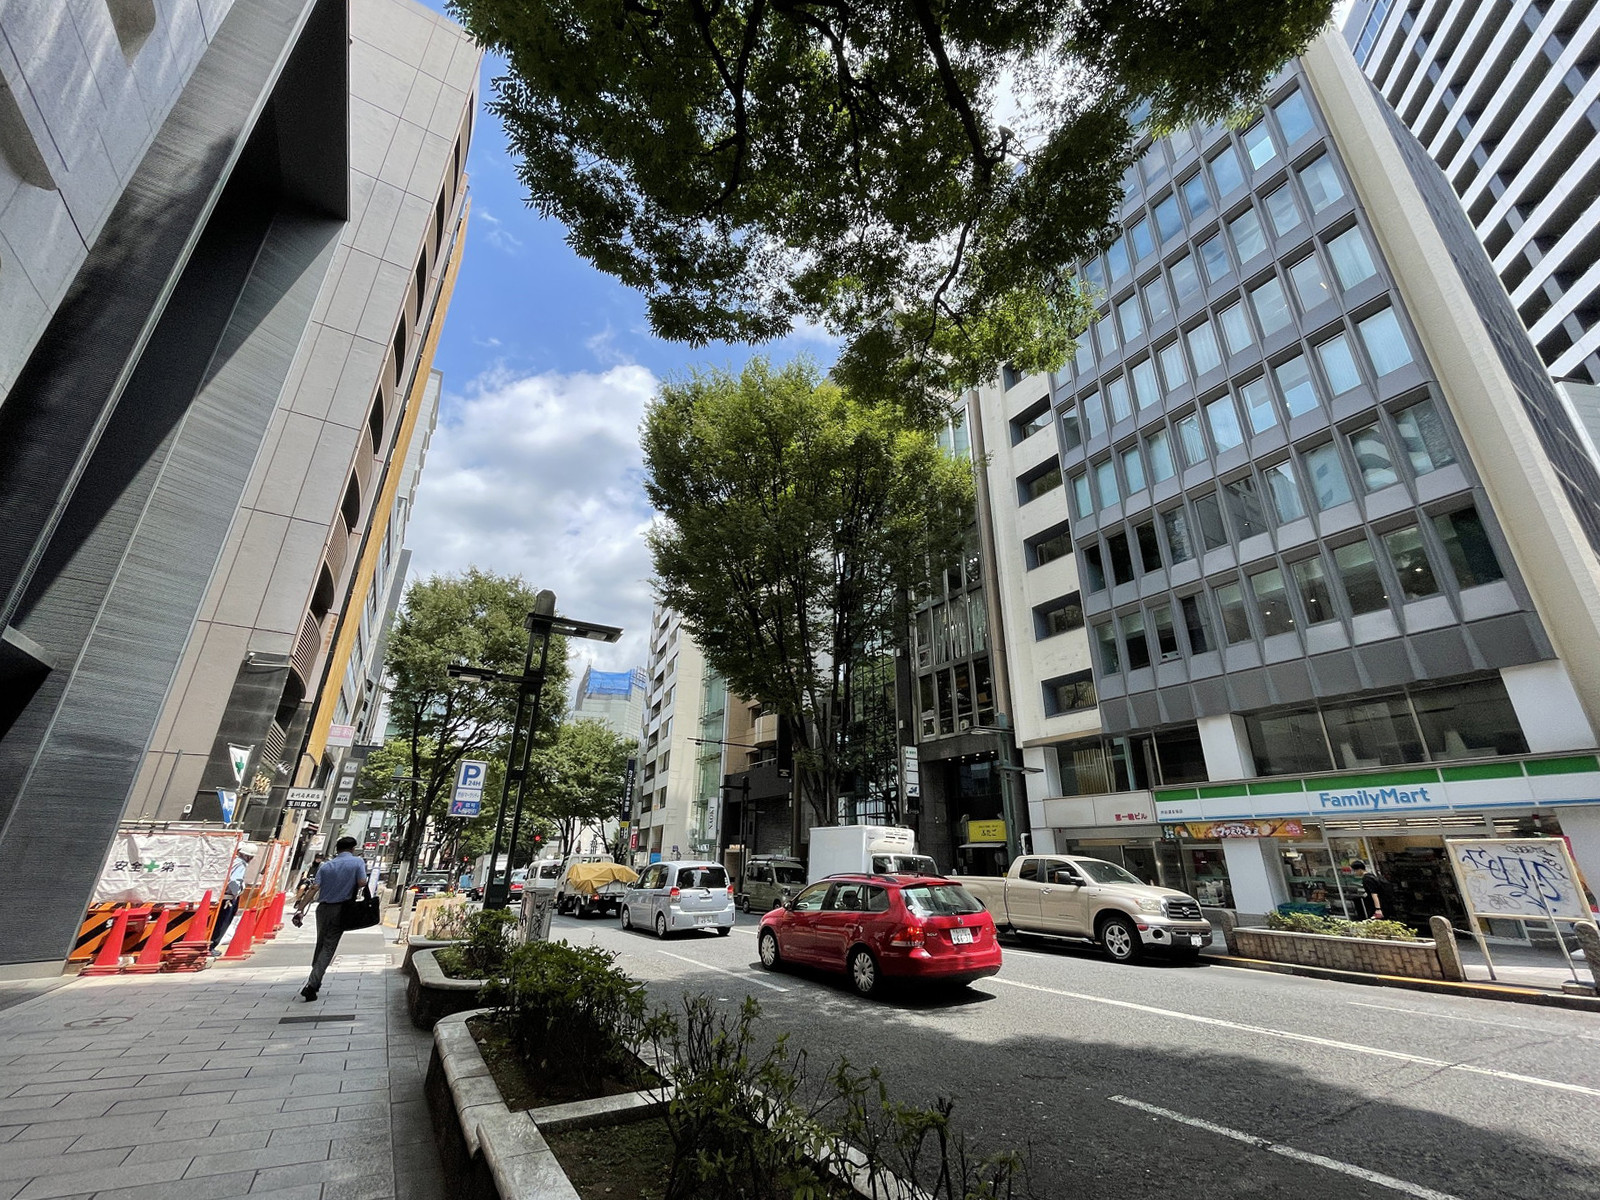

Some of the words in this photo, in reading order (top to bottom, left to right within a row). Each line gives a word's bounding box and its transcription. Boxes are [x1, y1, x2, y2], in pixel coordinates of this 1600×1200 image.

[462, 765, 481, 785] P
[1319, 787, 1431, 808] FamilyMart
[112, 860, 142, 873] 安全
[160, 861, 191, 873] 第一
